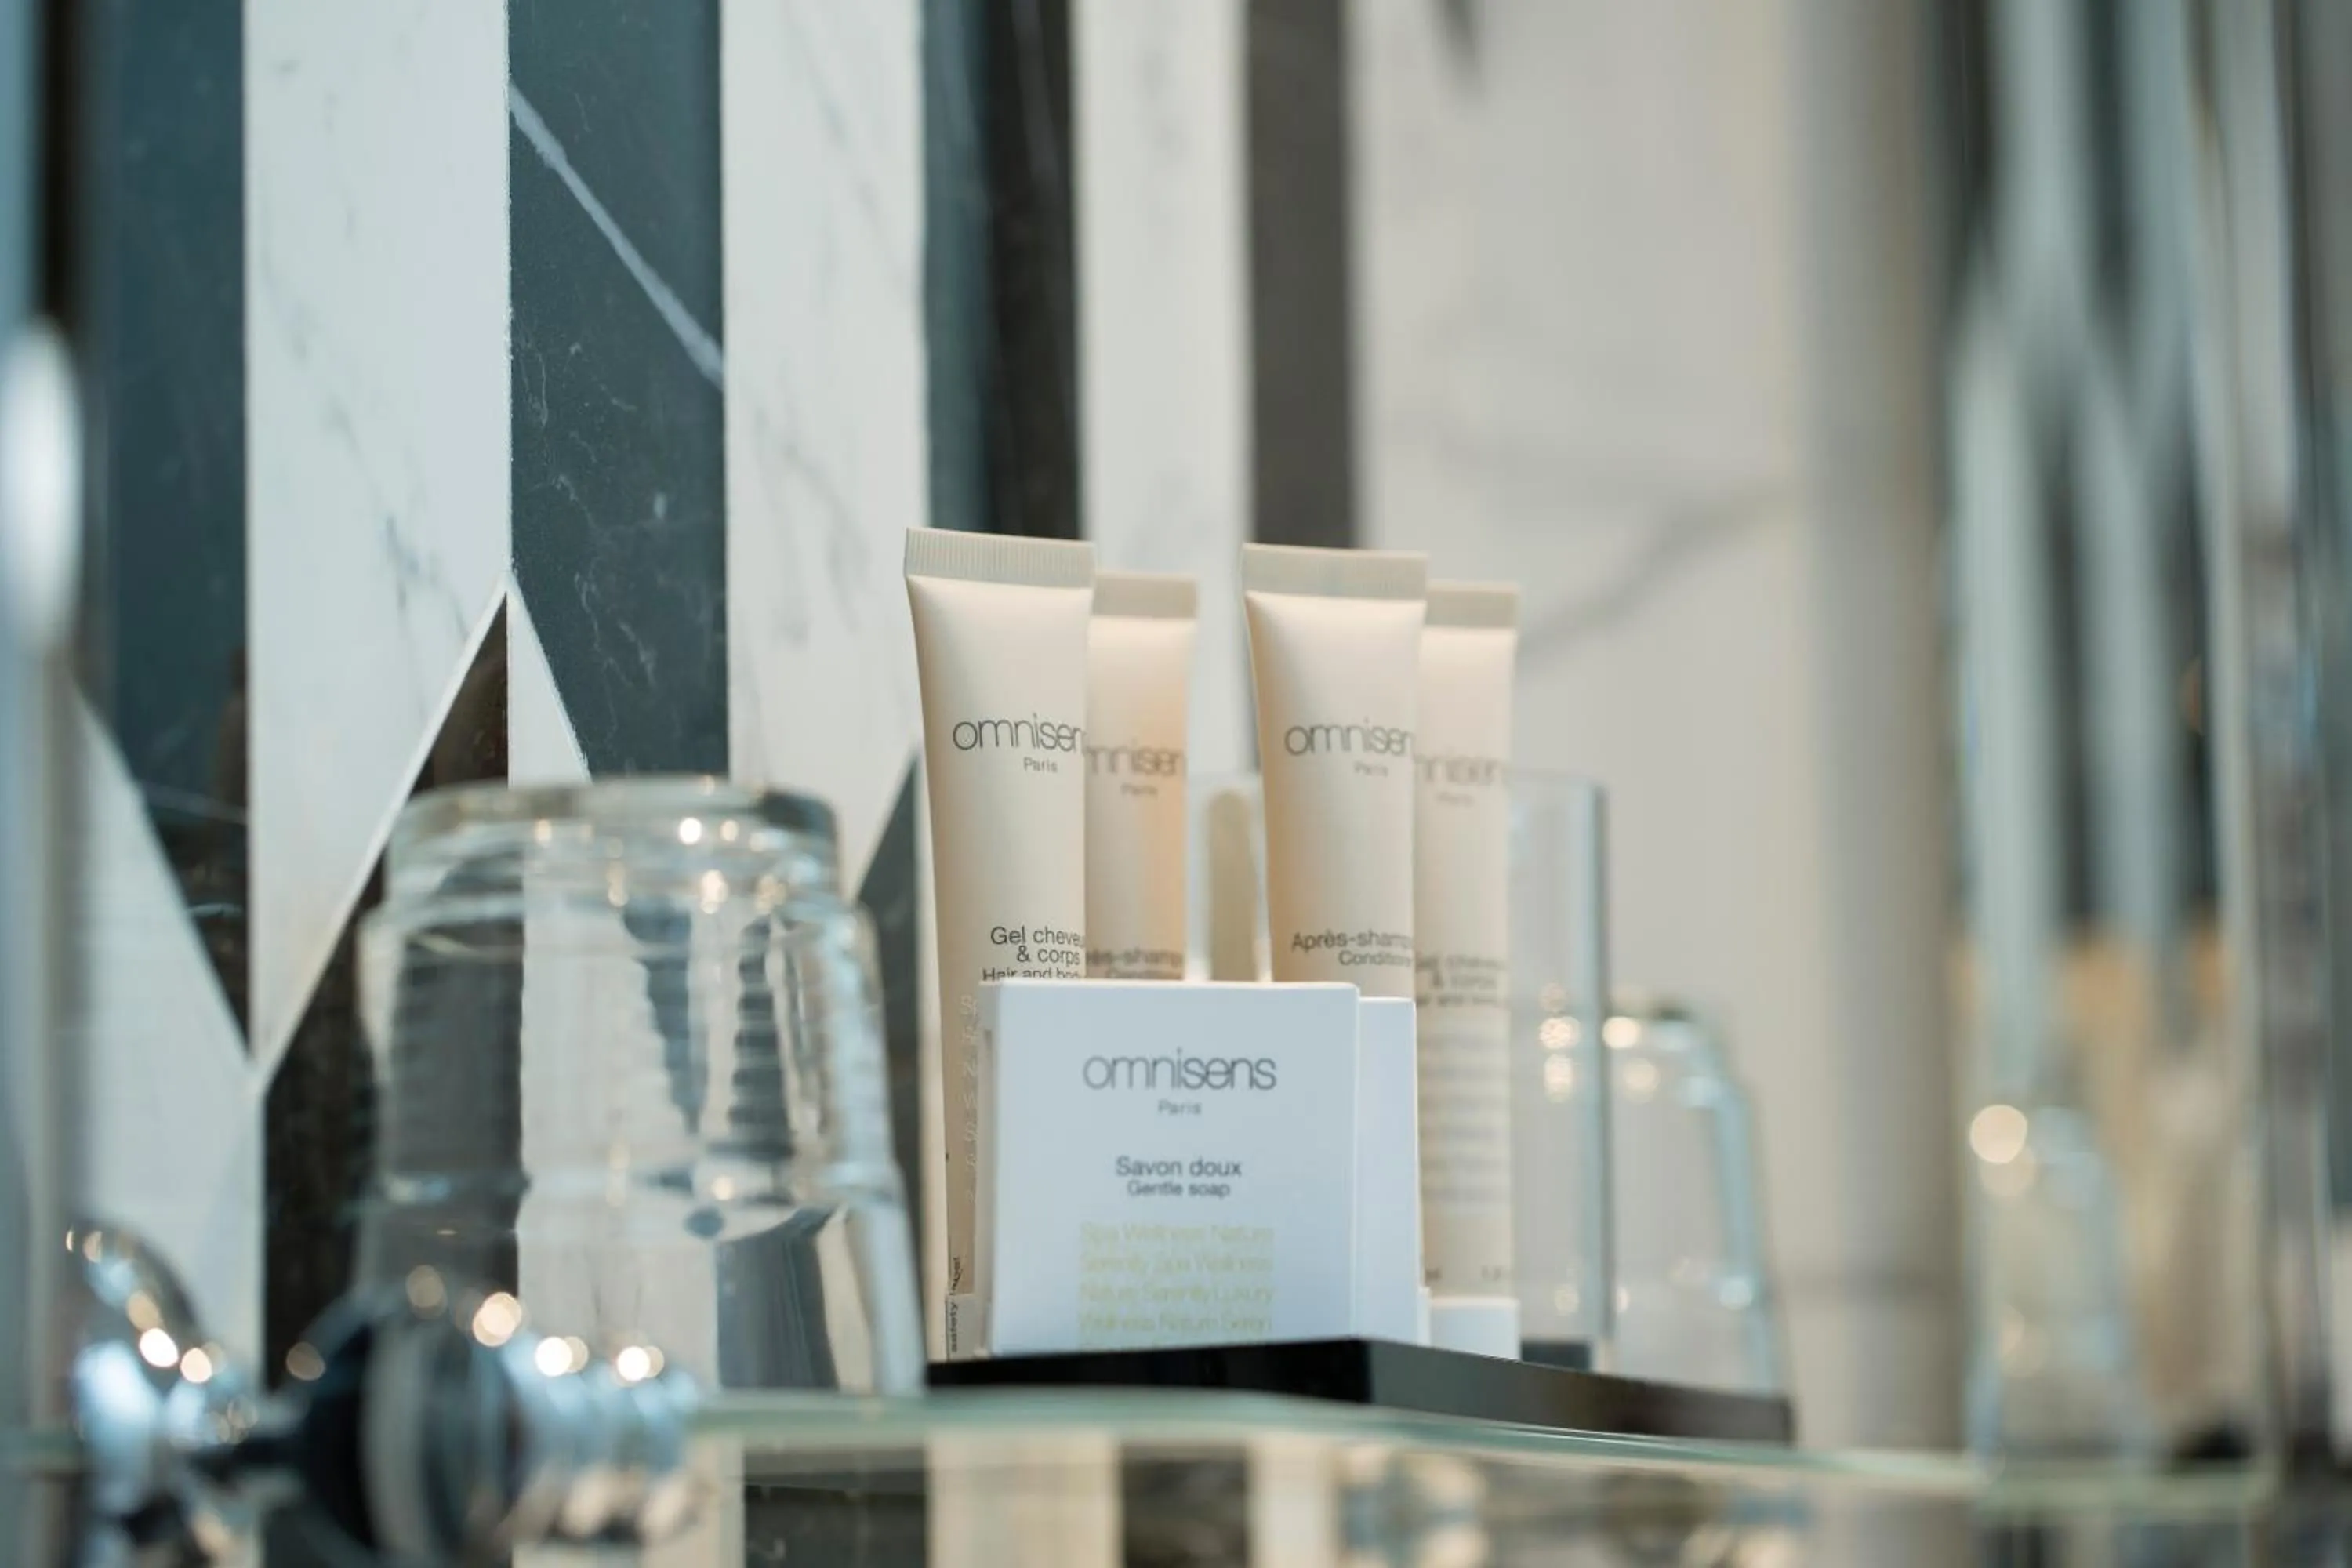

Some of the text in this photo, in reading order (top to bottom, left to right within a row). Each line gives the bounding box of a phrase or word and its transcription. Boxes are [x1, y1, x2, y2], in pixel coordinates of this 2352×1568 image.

[952, 713, 1084, 753] omnisen
[1283, 717, 1416, 757] omnisen
[1023, 757, 1058, 774] Paris
[990, 925, 1085, 948] Gel cheve
[1016, 945, 1080, 967] & corps
[1083, 1046, 1277, 1091] omnisens
[1158, 1098, 1203, 1116] Paris
[1116, 1155, 1243, 1178] Savon doux
[1127, 1179, 1231, 1200] Gentle soap
